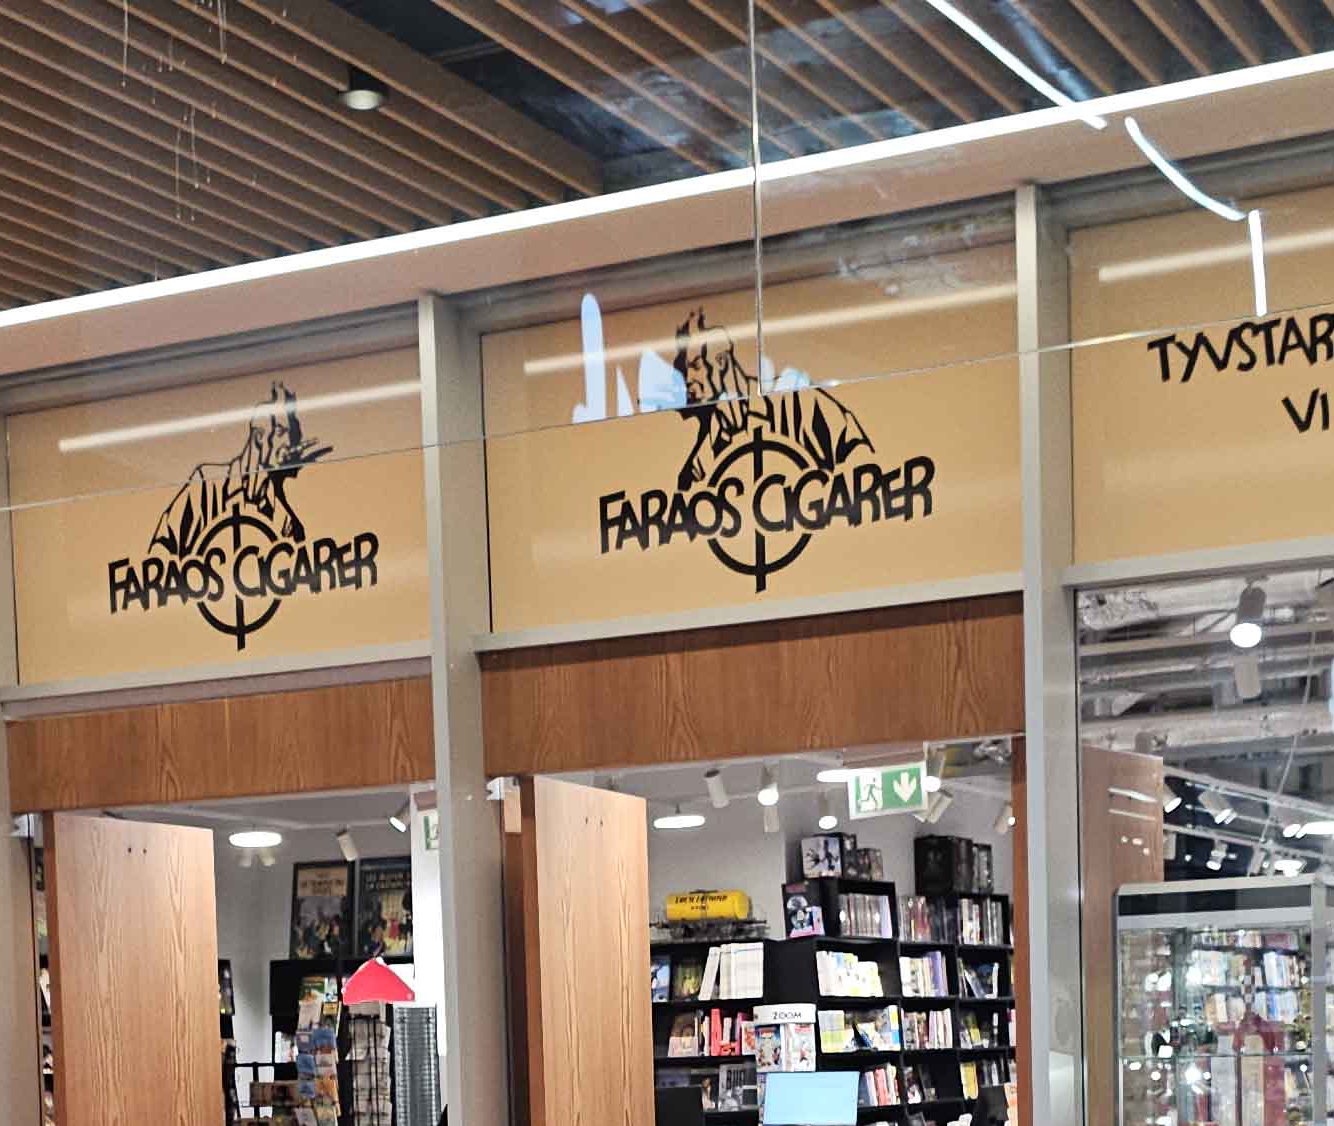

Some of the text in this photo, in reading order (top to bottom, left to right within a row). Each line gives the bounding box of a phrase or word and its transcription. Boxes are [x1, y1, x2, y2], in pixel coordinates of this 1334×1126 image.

[1282, 388, 1330, 433] VI
[599, 455, 935, 555] FARAOS CIGARER
[108, 532, 379, 615] FARAOS CIGARER
